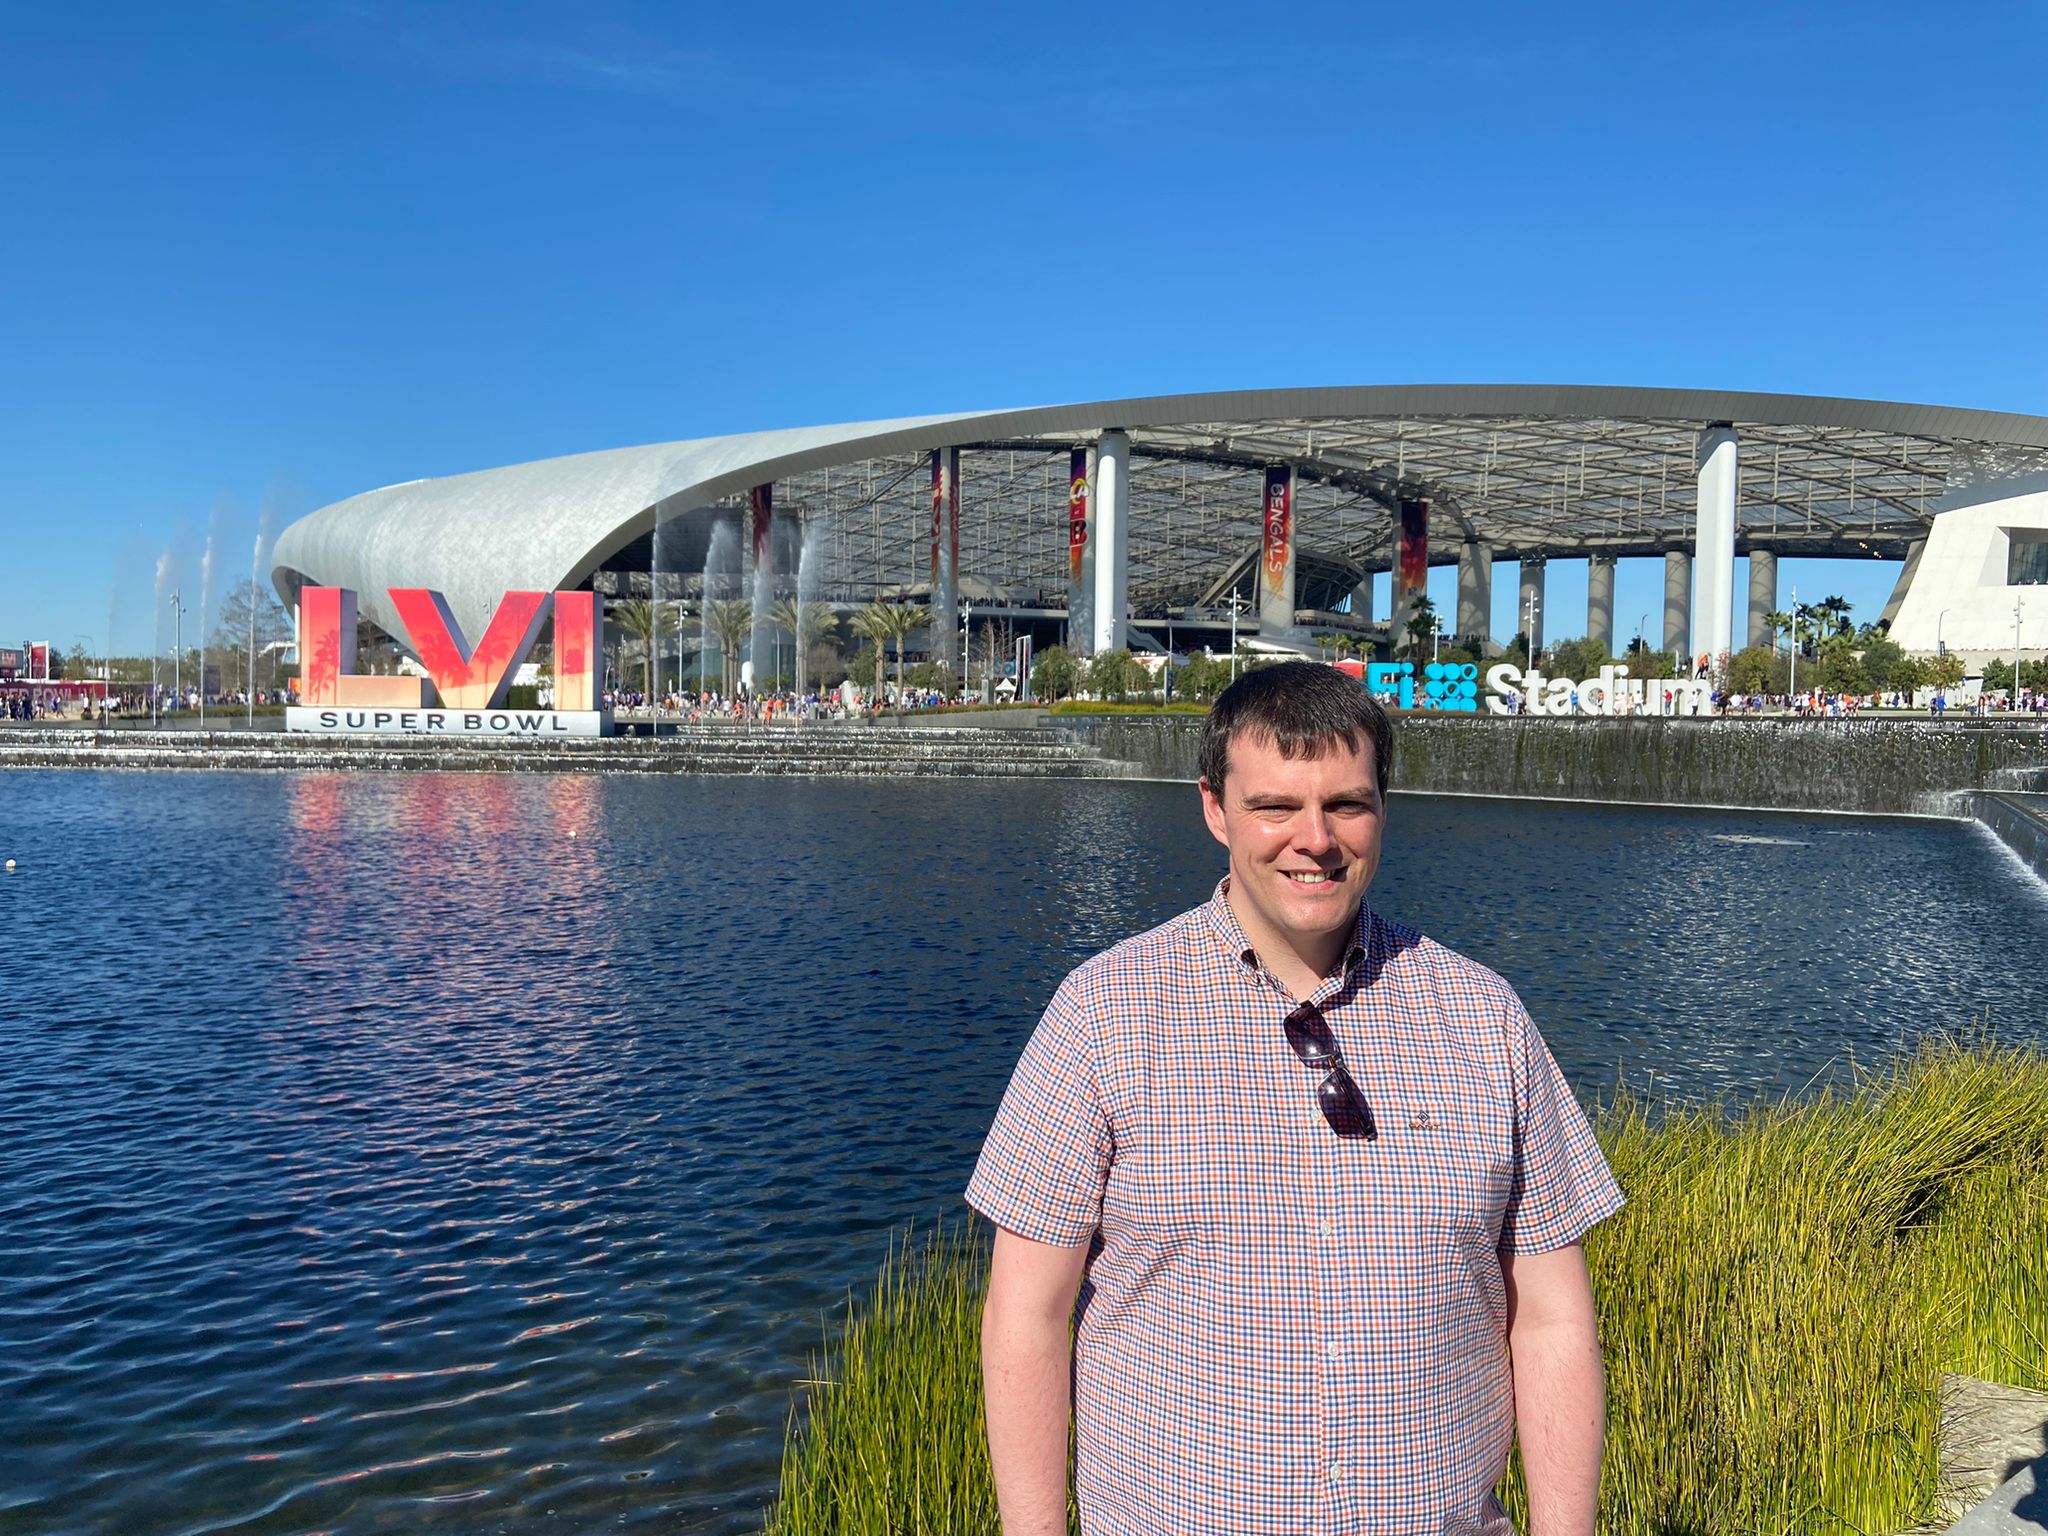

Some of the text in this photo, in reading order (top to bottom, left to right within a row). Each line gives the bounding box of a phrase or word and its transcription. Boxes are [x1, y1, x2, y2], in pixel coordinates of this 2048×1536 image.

[1269, 483, 1285, 573] BENGALS
[301, 586, 602, 711] LVI
[320, 712, 568, 731] SUPER BOWL
[1486, 663, 1713, 716] Stadium
